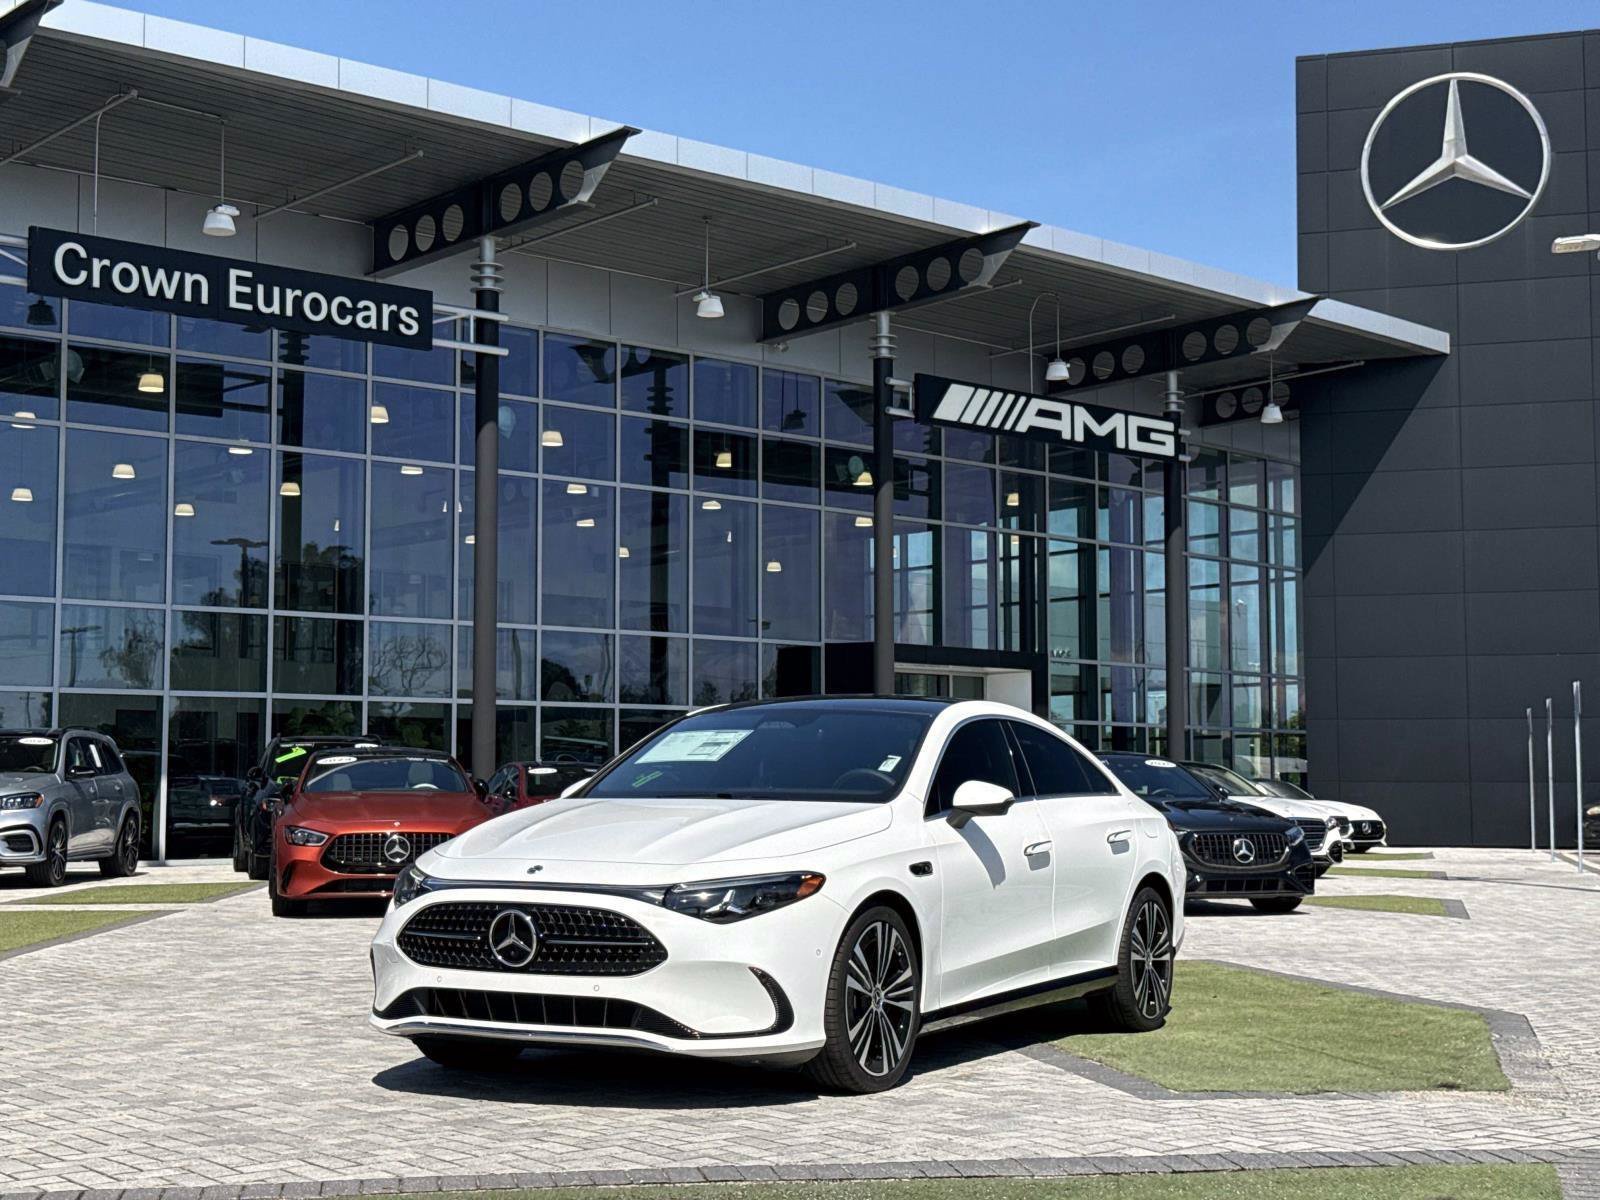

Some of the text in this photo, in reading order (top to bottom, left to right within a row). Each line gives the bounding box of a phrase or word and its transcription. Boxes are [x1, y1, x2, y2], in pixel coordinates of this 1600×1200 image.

[54, 242, 420, 336] Crown Eurocars
[1015, 397, 1175, 457] AMG
